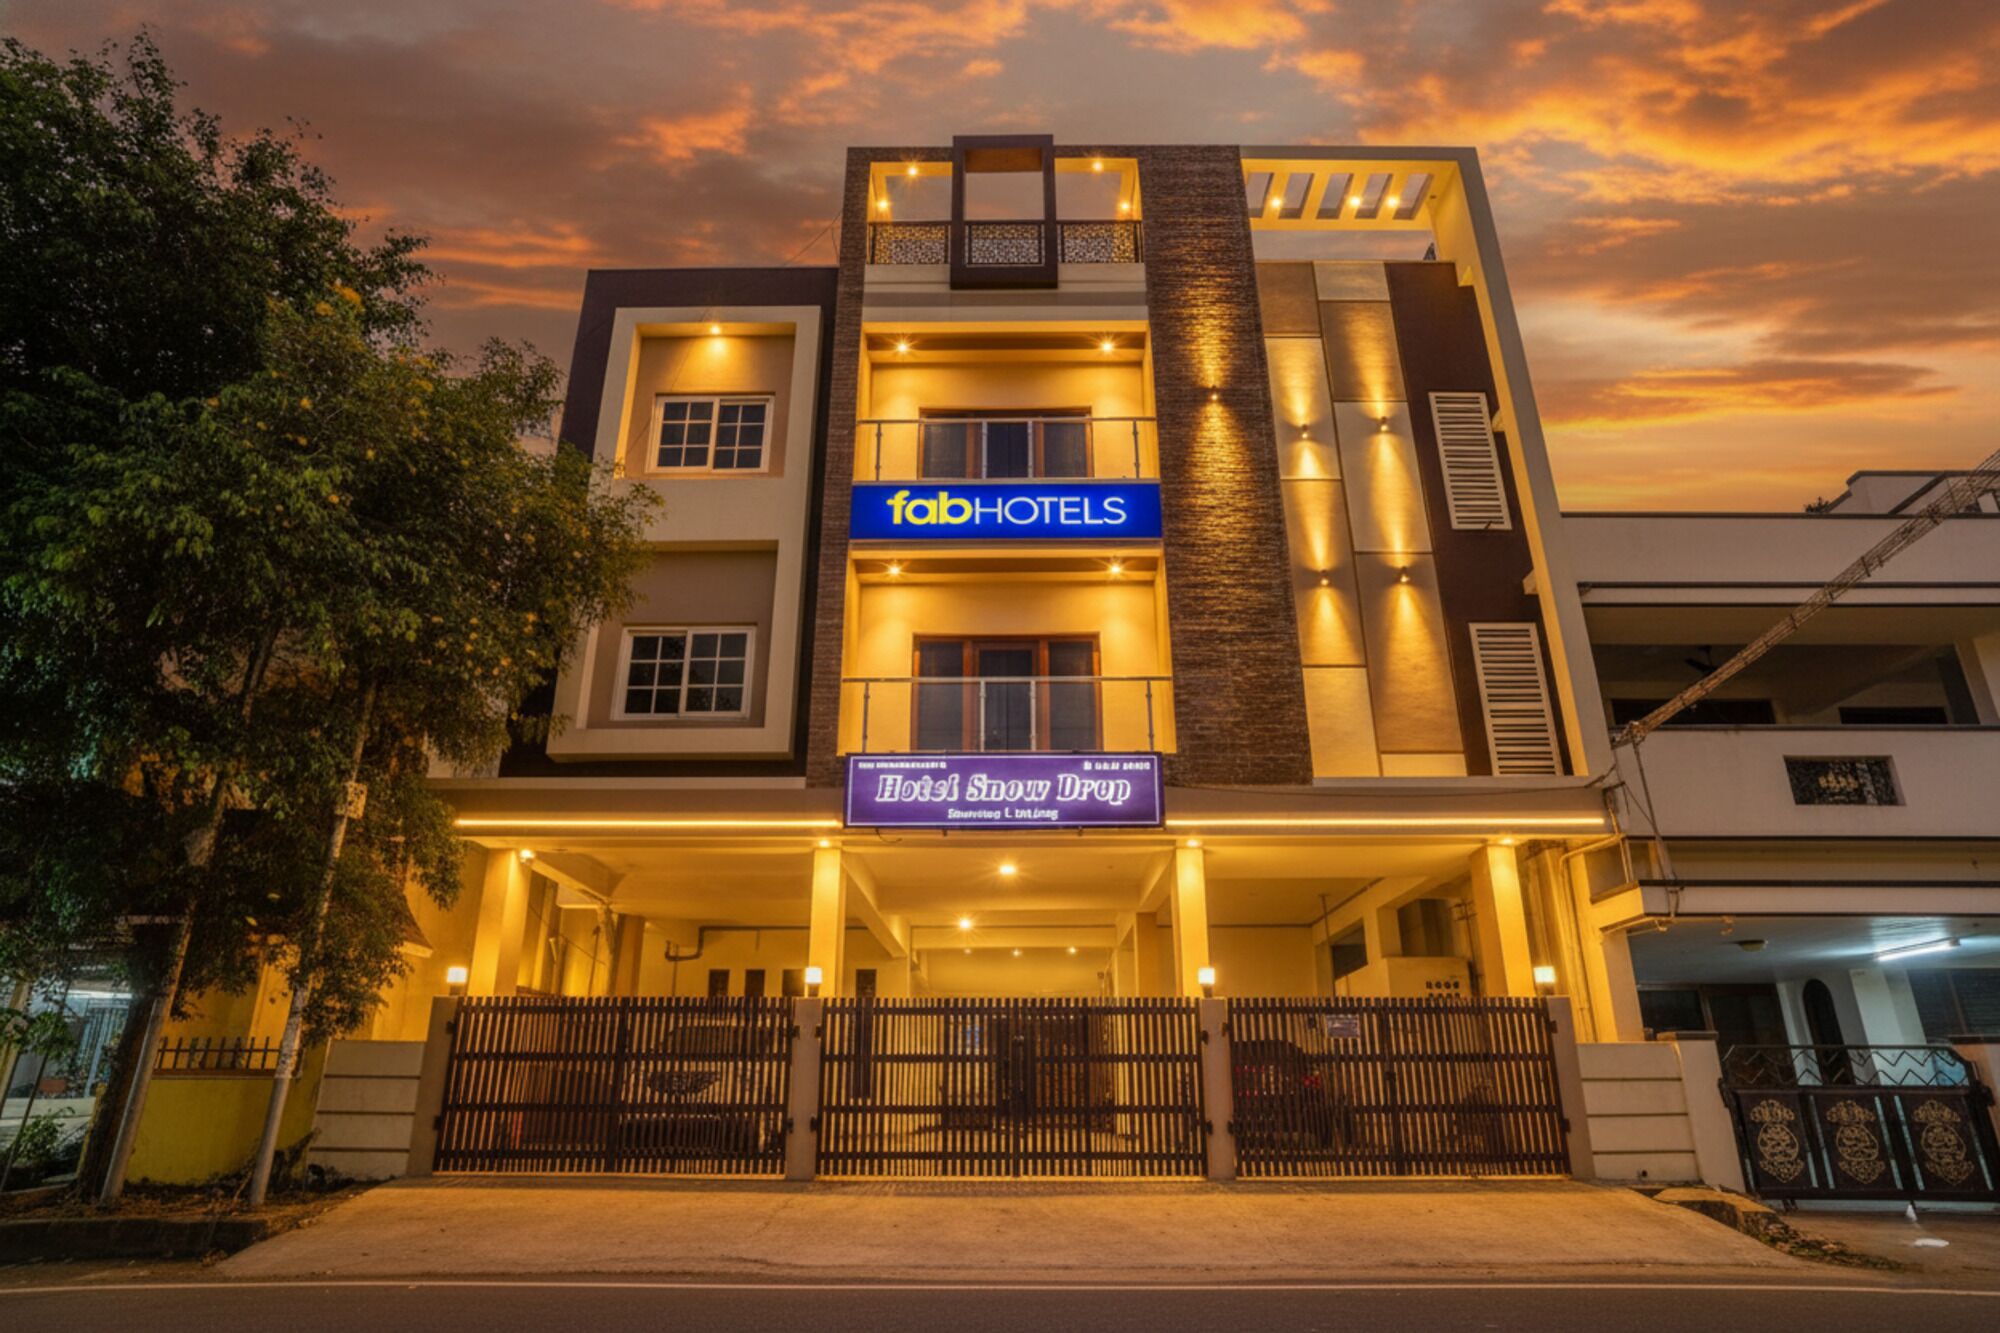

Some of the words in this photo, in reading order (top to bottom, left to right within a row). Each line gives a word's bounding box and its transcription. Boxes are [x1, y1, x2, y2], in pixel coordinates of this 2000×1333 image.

[886, 490, 1127, 525] fabHOTELS
[875, 774, 960, 802] Hotel
[966, 773, 1051, 802] Snow
[1056, 774, 1131, 805] Drop
